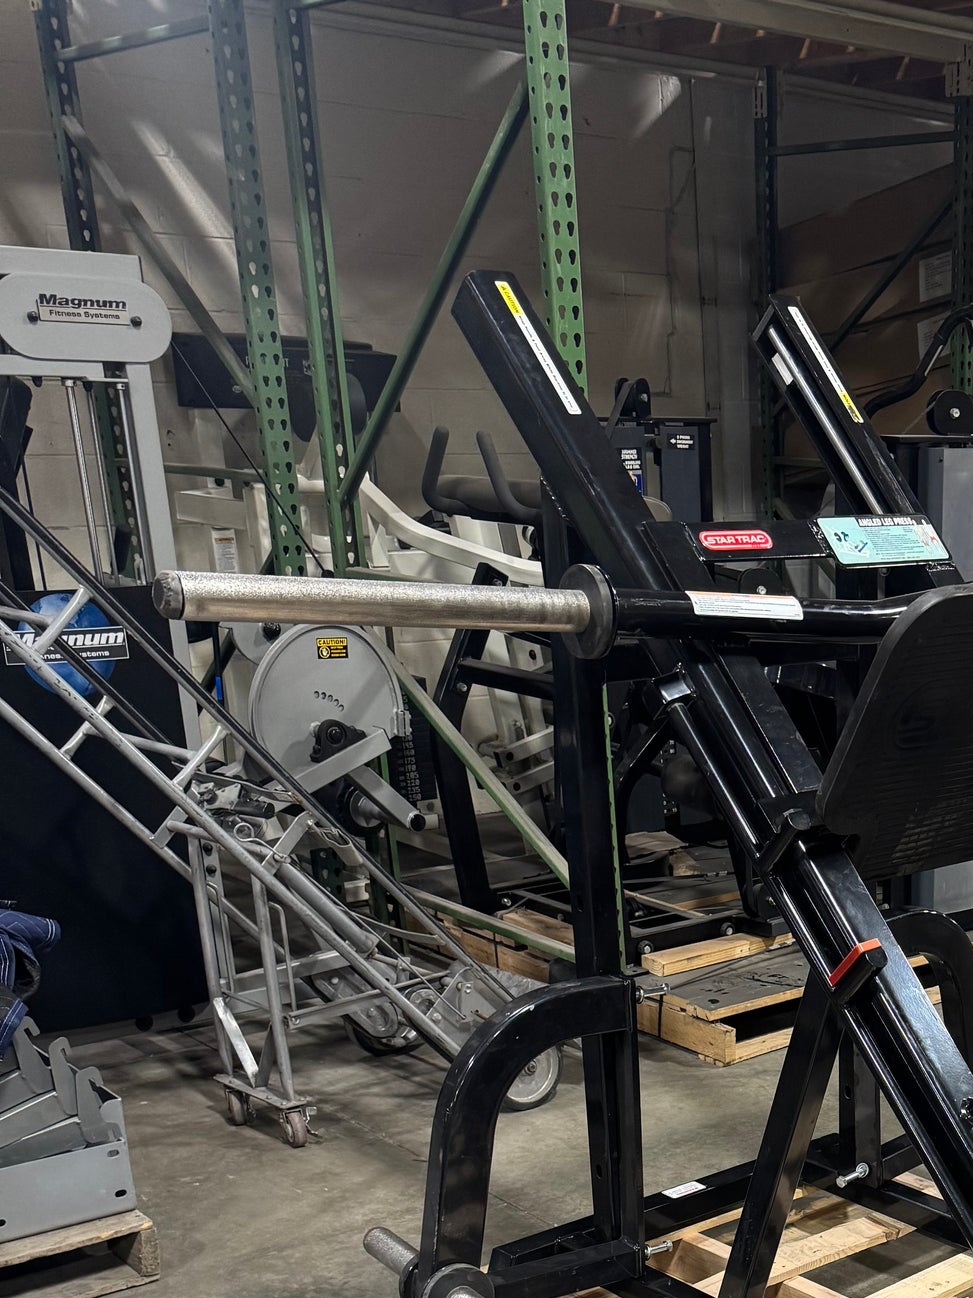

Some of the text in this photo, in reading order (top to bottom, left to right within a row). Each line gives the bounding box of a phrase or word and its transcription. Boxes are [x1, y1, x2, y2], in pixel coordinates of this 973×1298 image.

[39, 294, 126, 309] Magnum
[49, 309, 120, 320] Fitness Systems
[858, 518, 882, 526] ANGLED
[880, 517, 894, 525] LEG
[707, 535, 766, 544] STAR TRAC
